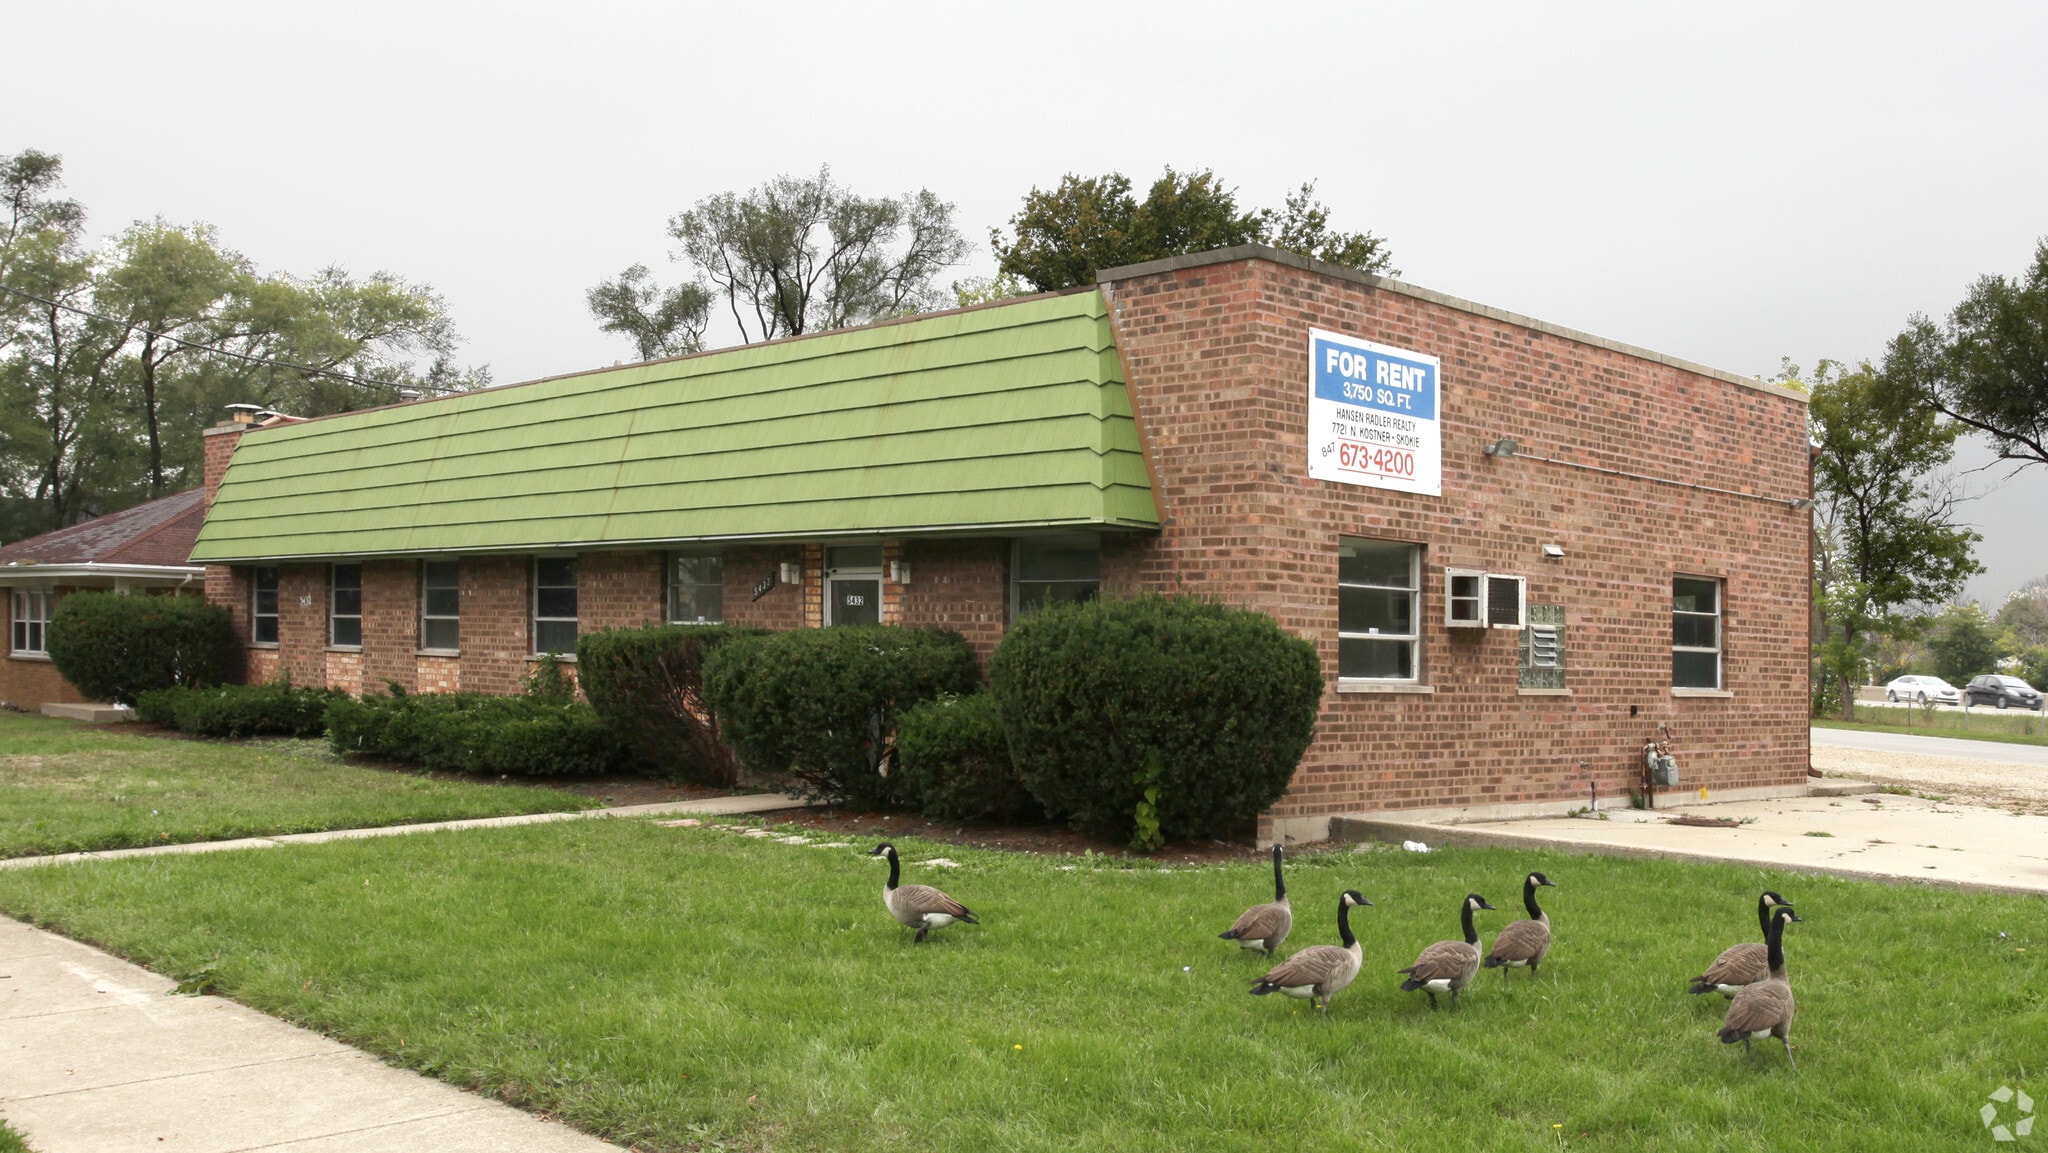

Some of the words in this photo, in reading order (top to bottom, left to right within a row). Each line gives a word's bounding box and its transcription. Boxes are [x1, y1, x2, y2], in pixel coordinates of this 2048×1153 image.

[1327, 348, 1367, 381] FOR
[1376, 359, 1426, 393] RENT
[1343, 381, 1373, 402] 3,750
[1377, 388, 1395, 407] SQ.
[1397, 393, 1412, 410] FT.
[1336, 407, 1364, 424] HANSEN
[1365, 413, 1392, 428] RADLER
[1392, 417, 1416, 433] REALTY
[1331, 421, 1347, 436] 7721
[1359, 427, 1391, 443] KOSTNER
[1396, 433, 1420, 448] SKOKIE
[1321, 441, 1335, 458] 847
[846, 595, 864, 606] 5432
